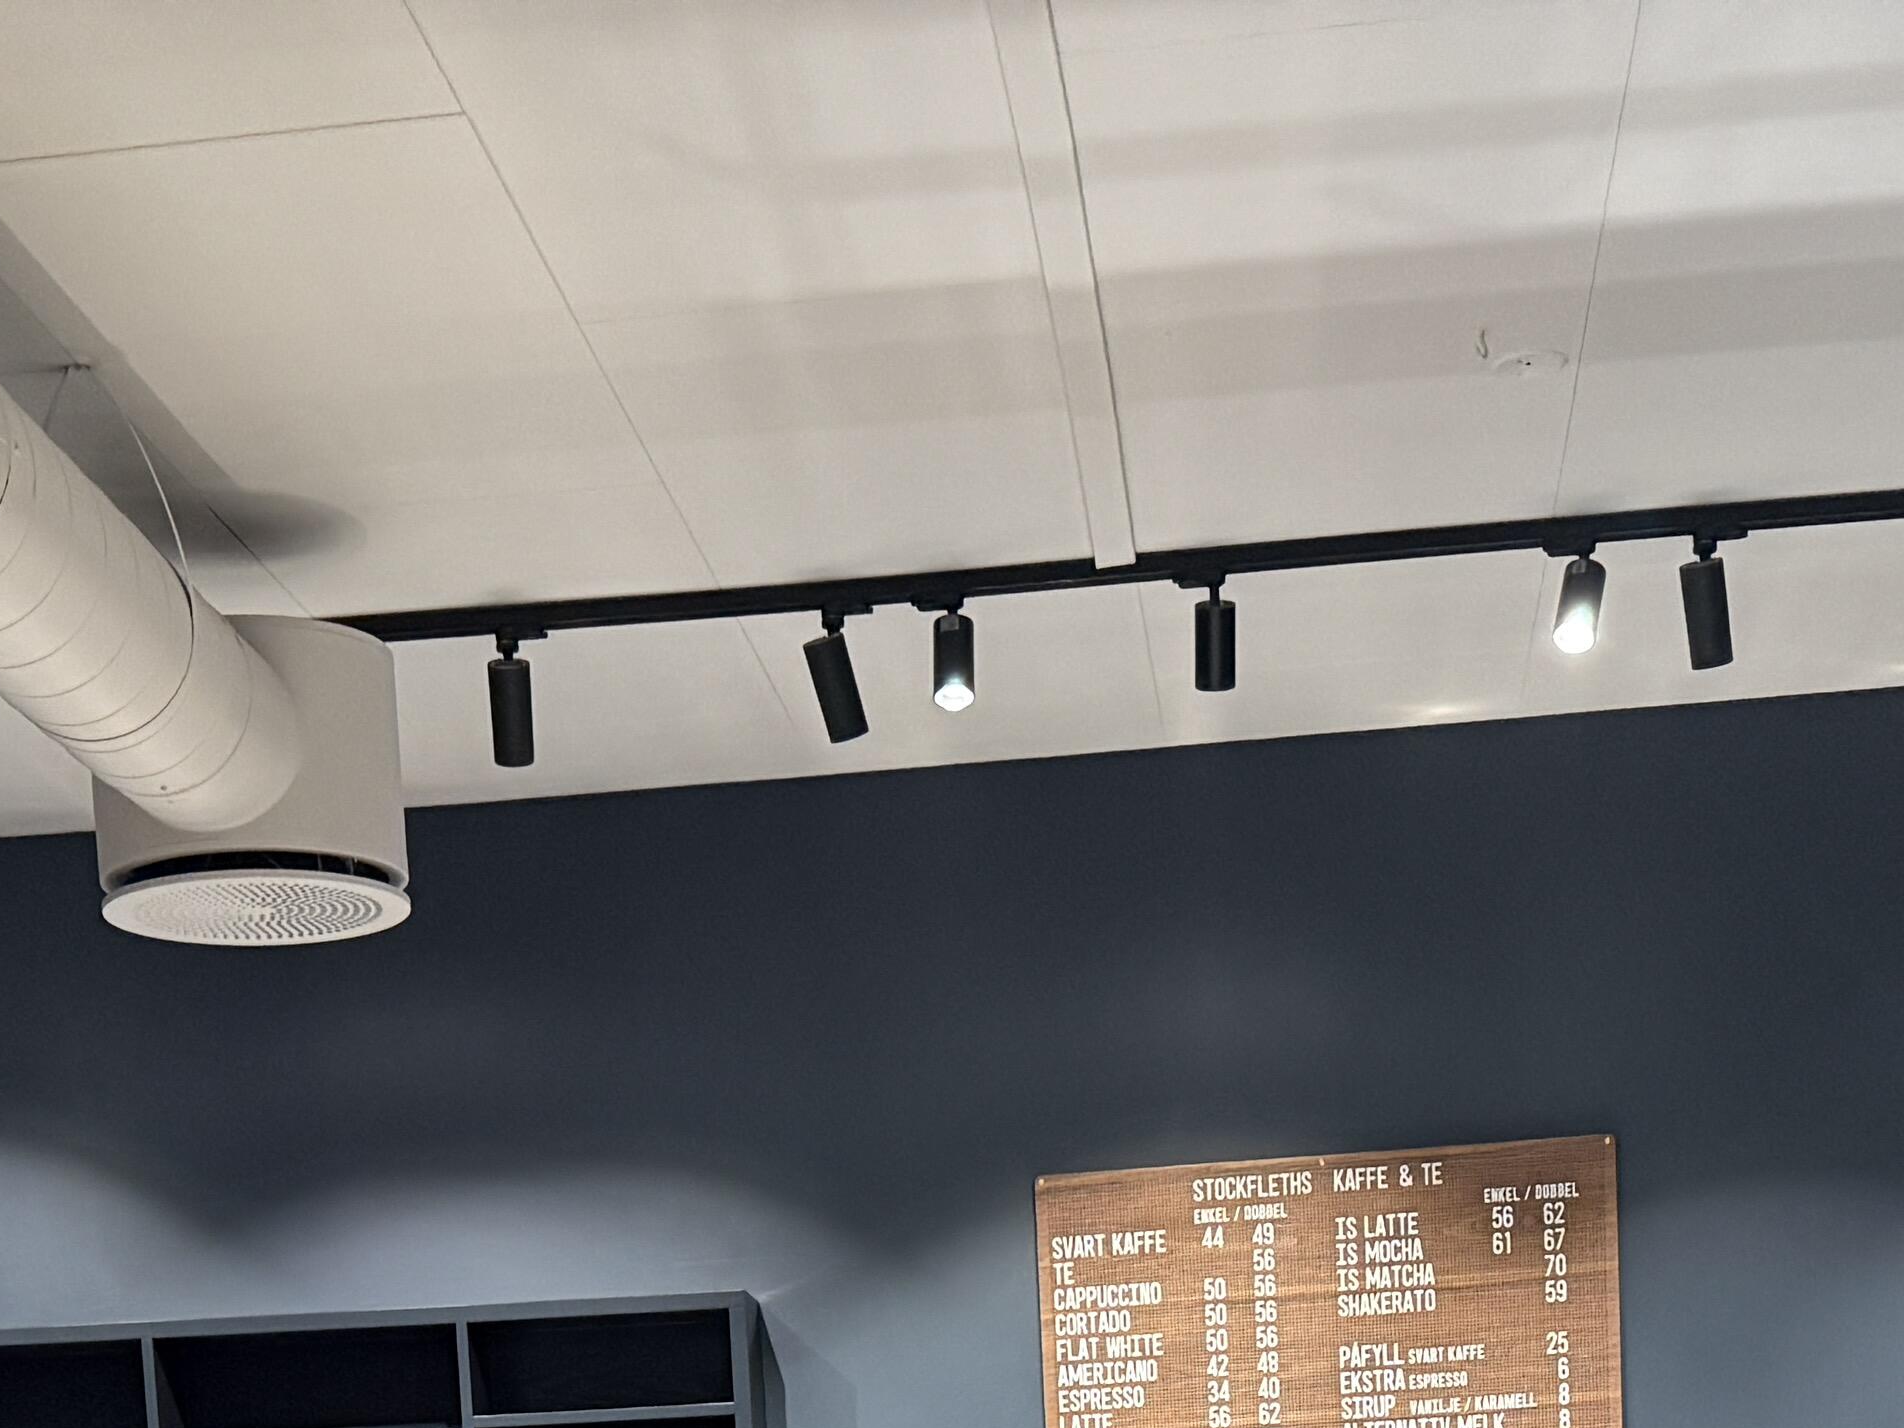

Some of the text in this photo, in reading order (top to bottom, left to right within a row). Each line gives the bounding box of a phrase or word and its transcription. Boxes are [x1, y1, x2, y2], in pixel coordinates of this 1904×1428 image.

[1193, 1162, 1443, 1201] STOCKFLETHS KAFFE & TE
[1484, 1182, 1579, 1203] ENKEL / DOBBEL
[1193, 1203, 1288, 1224] ENKEL / DOBBEL
[1335, 1202, 1564, 1240] IS LATTE 56 62
[1052, 1223, 1275, 1259] SVART KAFFE 44 49
[1336, 1228, 1565, 1266] IS MOCHA 61 67
[1053, 1249, 1276, 1285] TE 56
[1337, 1254, 1567, 1291] IS MATCHA 70
[1054, 1275, 1276, 1310] CAPPUCCINO 50 56
[1337, 1280, 1567, 1317] SHAKERATO 59
[1055, 1301, 1277, 1336] CORTADO 50 56
[1056, 1326, 1278, 1362] FLAT WHITE 50 56
[1339, 1331, 1568, 1368] PÅFYLL SVART KAFFE 25
[1058, 1352, 1278, 1388] AMERICANO 42 48
[1340, 1357, 1569, 1394] EKSTRA ESPRESSO 6
[1059, 1377, 1280, 1412] ESPRESSO 34 40
[1341, 1382, 1570, 1420] SIRUP VANILJE / KARAMELL 8
[1208, 1405, 1231, 1428] 56
[1258, 1402, 1281, 1425] 62
